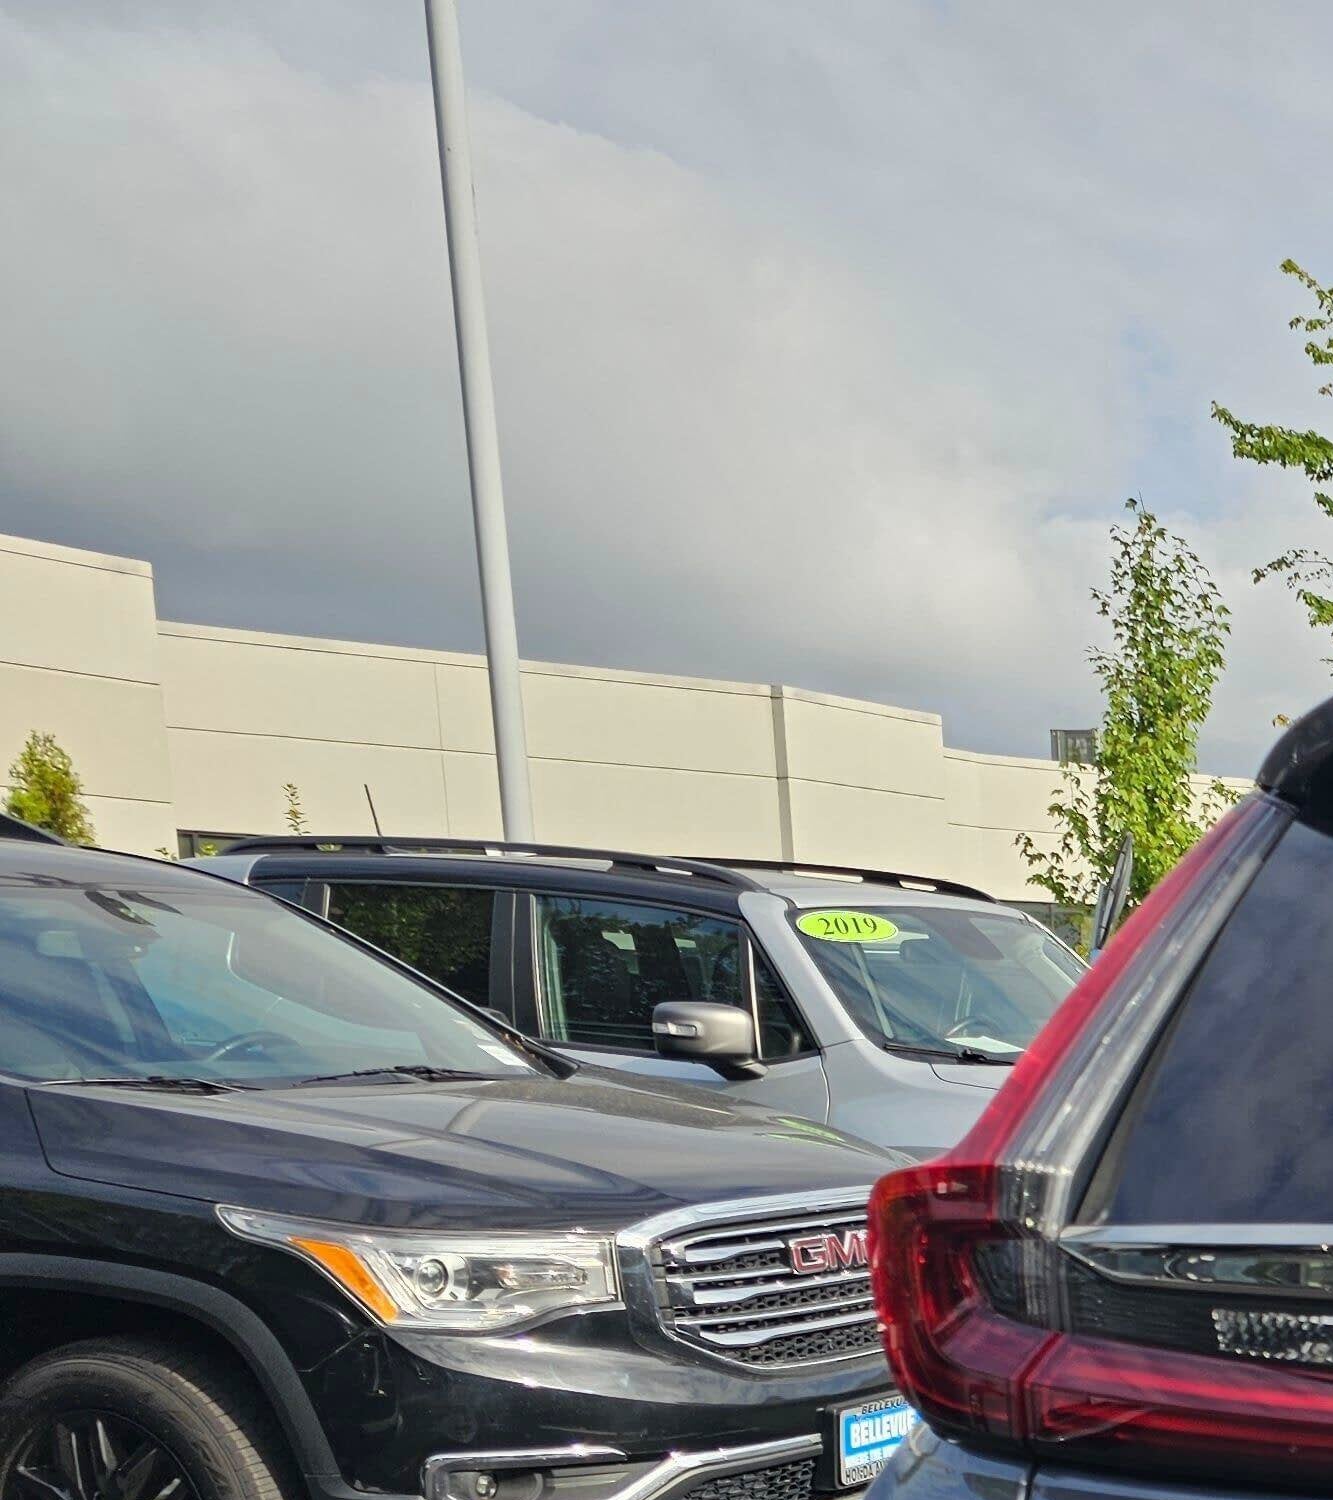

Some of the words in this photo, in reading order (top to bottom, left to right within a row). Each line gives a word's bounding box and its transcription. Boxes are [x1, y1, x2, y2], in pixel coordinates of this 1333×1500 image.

[817, 917, 878, 936] 2019
[789, 1228, 868, 1276] GM
[861, 1396, 904, 1415] BELLEVU
